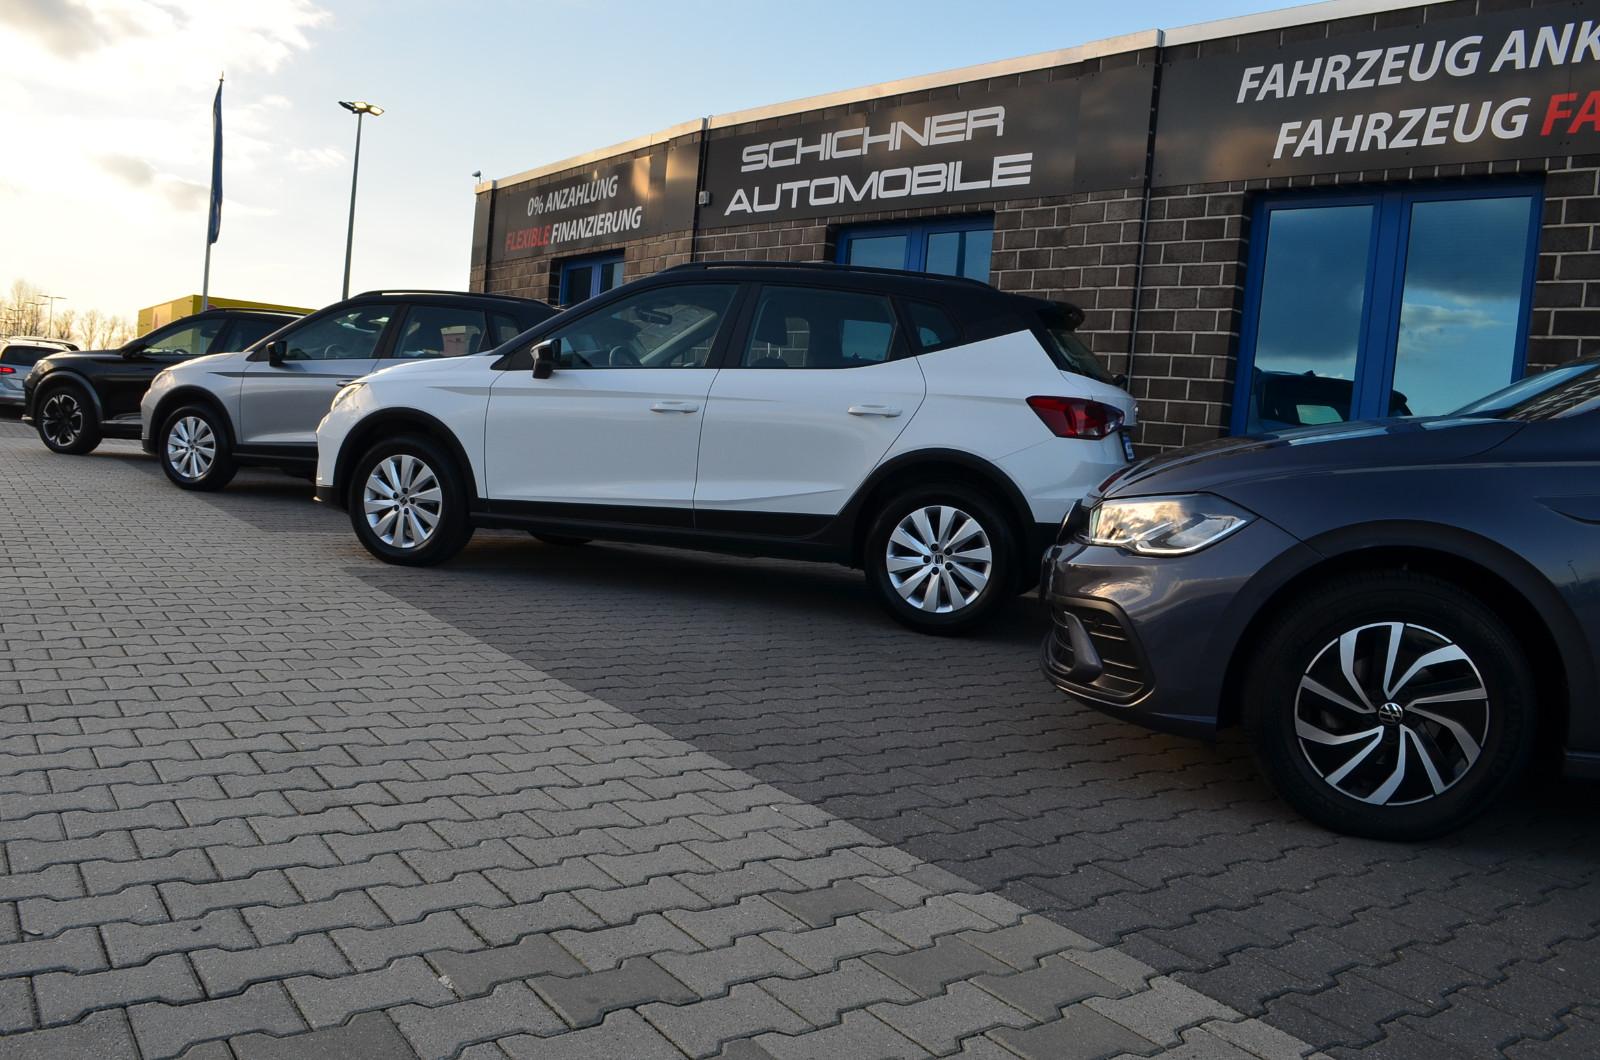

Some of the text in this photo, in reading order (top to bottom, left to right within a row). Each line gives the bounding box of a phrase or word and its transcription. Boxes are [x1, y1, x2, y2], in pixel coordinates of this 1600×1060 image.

[1236, 20, 1600, 104] FAHRZEUG ANK
[740, 105, 1006, 173] SCHICHNER
[1272, 89, 1600, 160] FAHRZEUG FA
[527, 174, 619, 217] 0% ANZAHLUNG
[724, 152, 1034, 216] AUTOMOBILE
[505, 205, 643, 251] FLEXIBLE FINANZIERUNG
